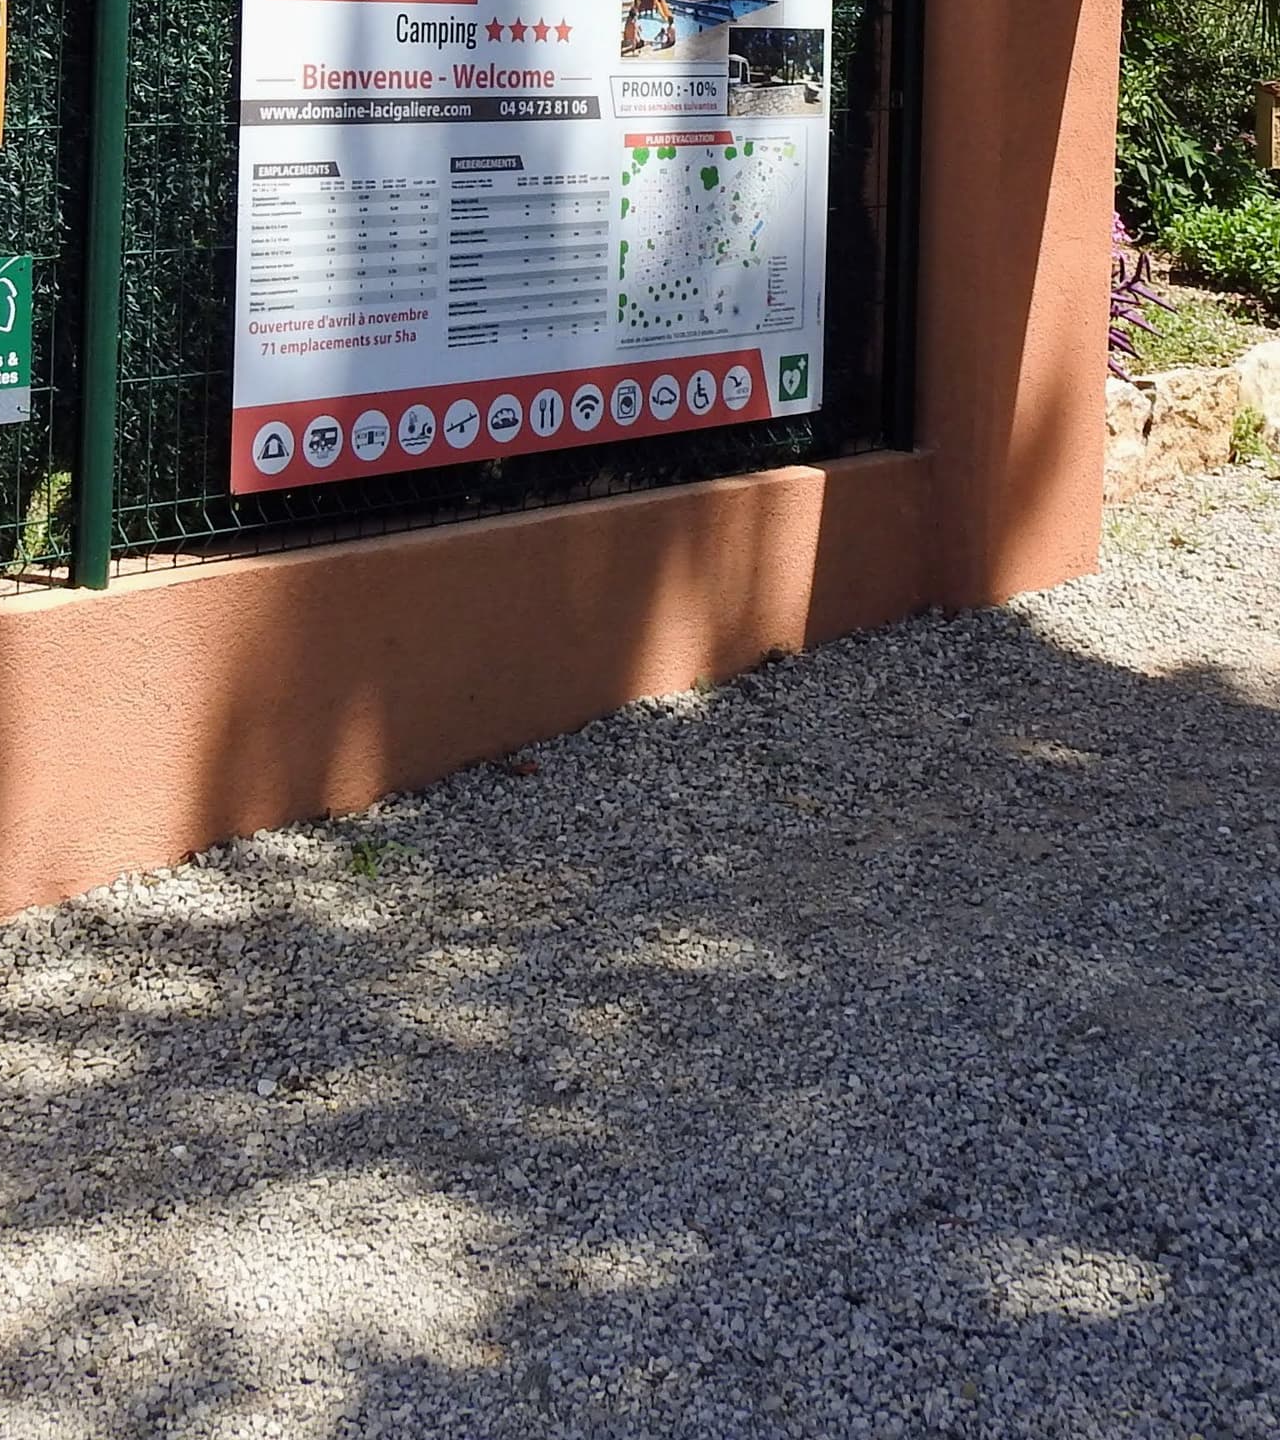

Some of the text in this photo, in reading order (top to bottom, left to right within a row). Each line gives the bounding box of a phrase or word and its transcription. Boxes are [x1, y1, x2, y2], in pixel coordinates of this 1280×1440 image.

[396, 13, 477, 50] Camping
[302, 63, 433, 90] Bienvenue
[453, 65, 555, 89] Welcome
[622, 81, 674, 98] PROMO
[683, 81, 717, 97] -10%
[259, 100, 588, 124] www.domaine-lacigaliere.com 04 94 73 81 06
[646, 135, 664, 145] PLAN
[258, 164, 330, 177] EMPLACEMENTS
[249, 308, 429, 335] Ouverture d'avril à novembre
[261, 330, 417, 356] 71 emplacements sur 5ha
[7, 351, 18, 366] &
